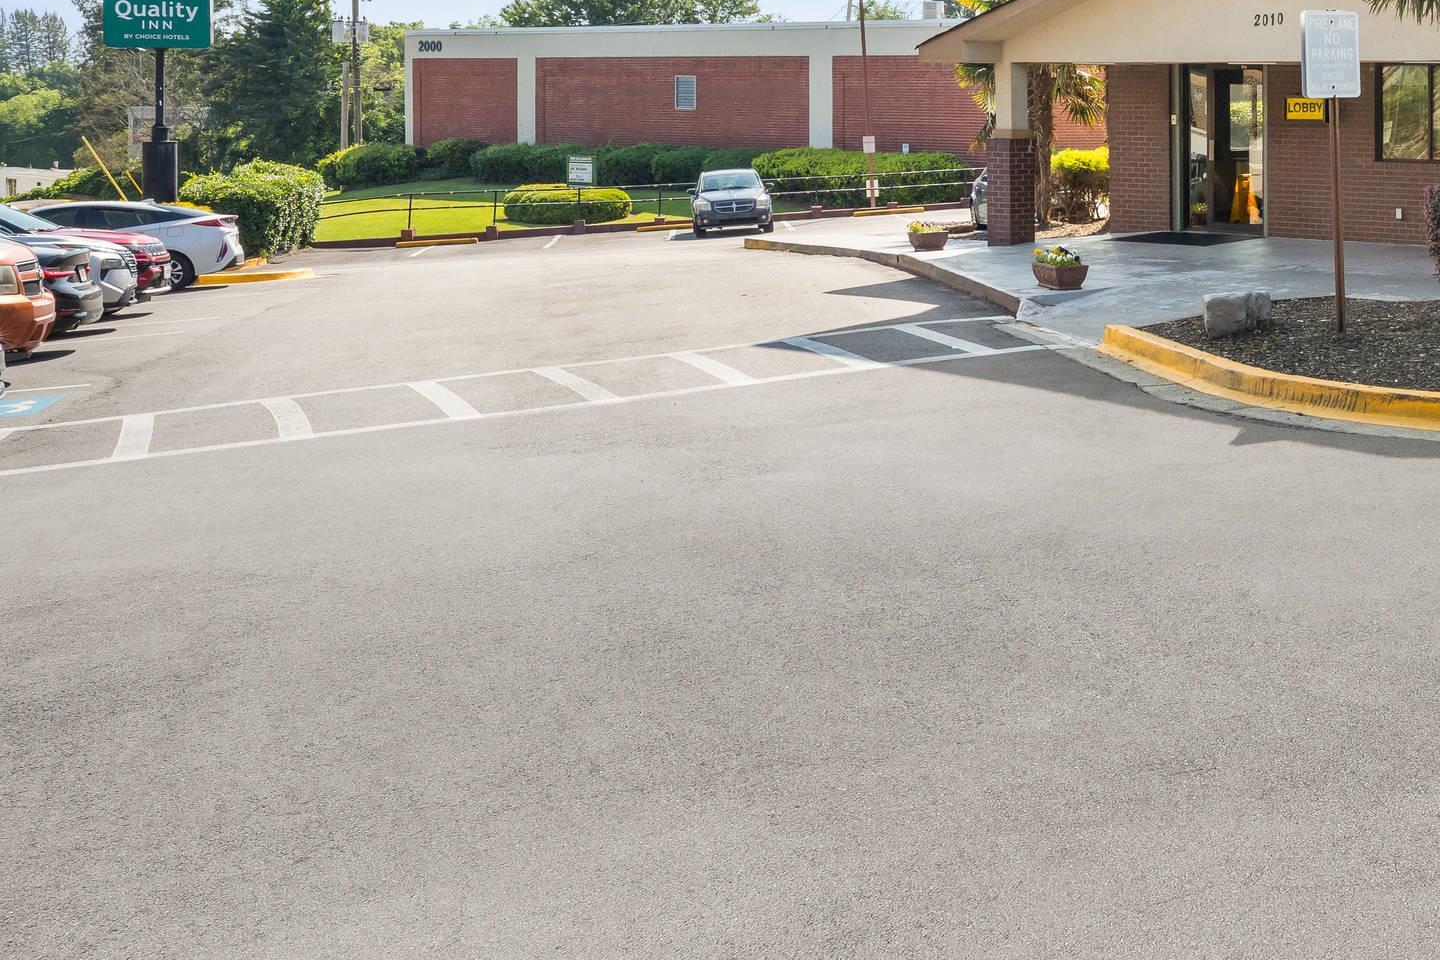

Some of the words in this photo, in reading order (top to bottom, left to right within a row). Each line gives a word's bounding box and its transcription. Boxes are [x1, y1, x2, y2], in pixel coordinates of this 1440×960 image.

[114, 0, 199, 22] Quality
[141, 19, 173, 30] INN
[1254, 12, 1284, 27] 2010
[1323, 32, 1341, 45] NO
[418, 40, 442, 52] 2000
[1311, 47, 1354, 60] PARKING
[1288, 102, 1323, 113] LOBBY
